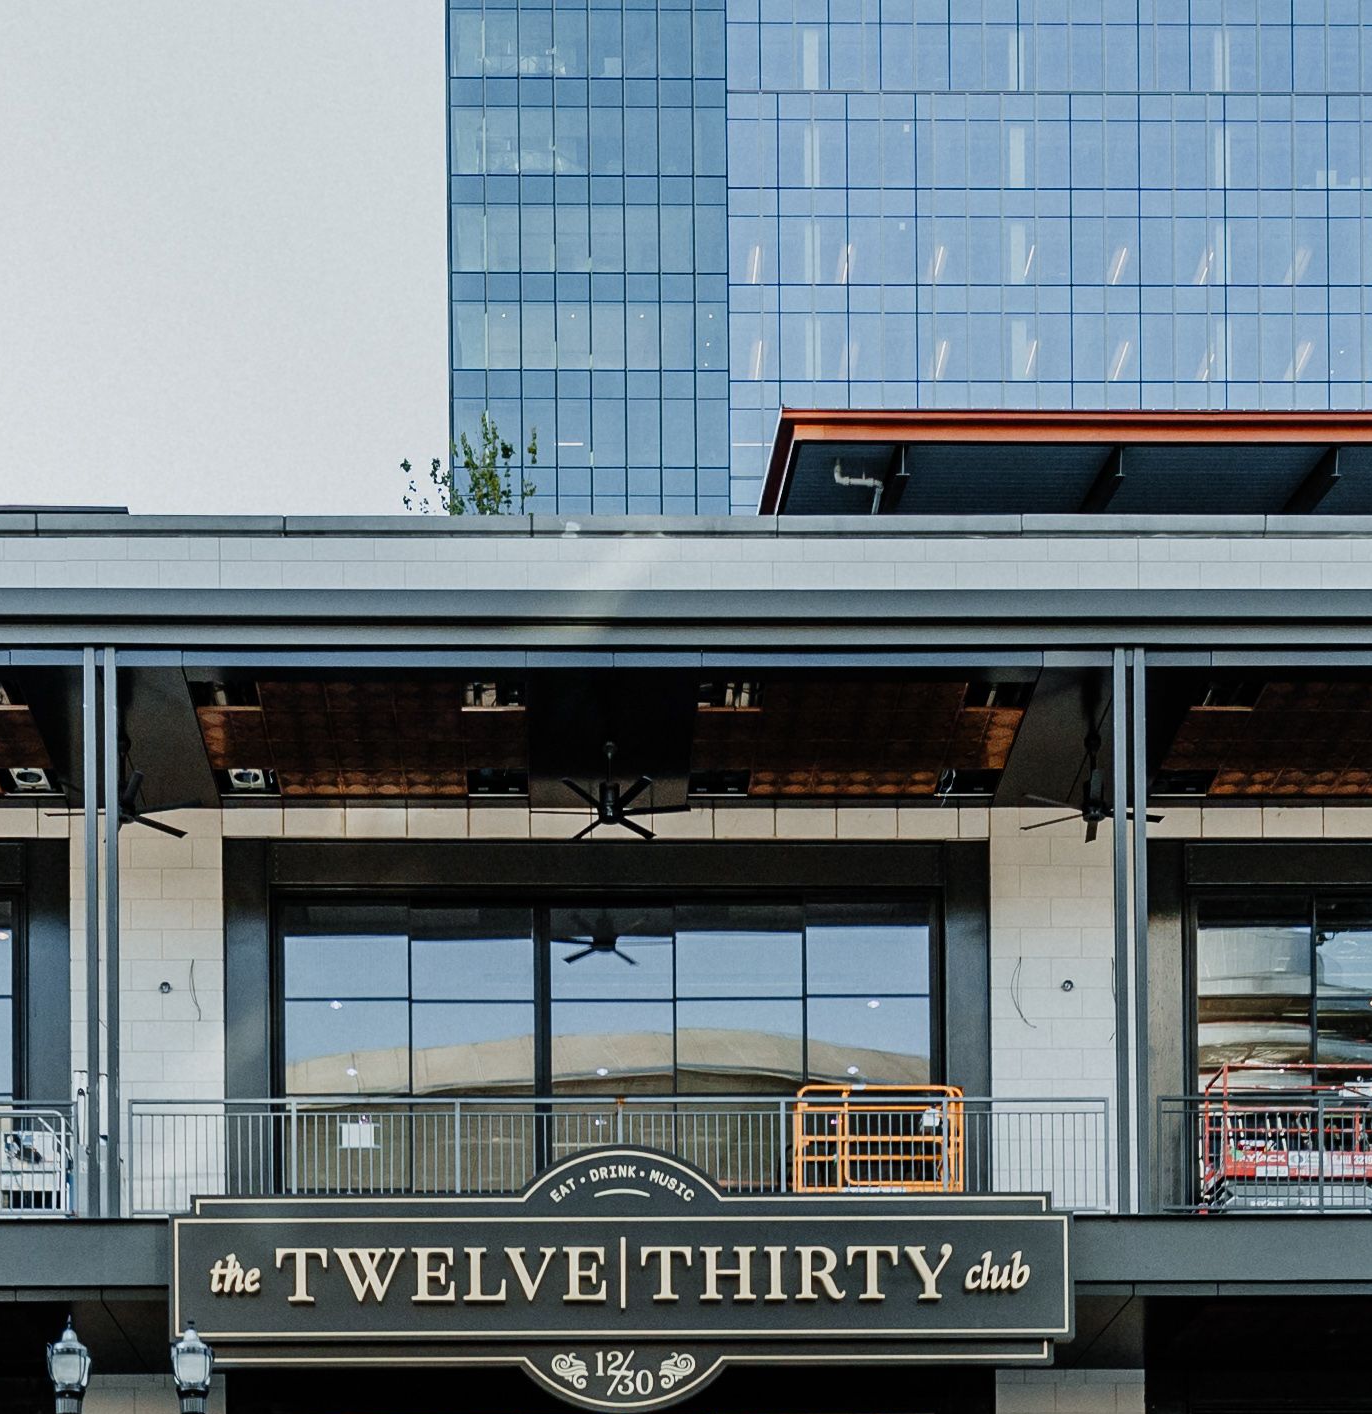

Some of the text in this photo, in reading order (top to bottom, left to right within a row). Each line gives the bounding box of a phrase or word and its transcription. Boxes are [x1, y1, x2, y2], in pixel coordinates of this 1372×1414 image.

[549, 1165, 695, 1203] EAT DRINK MUSIC
[210, 1243, 1031, 1302] the TWELVE THIRTY club
[595, 1350, 654, 1397] 12/30
